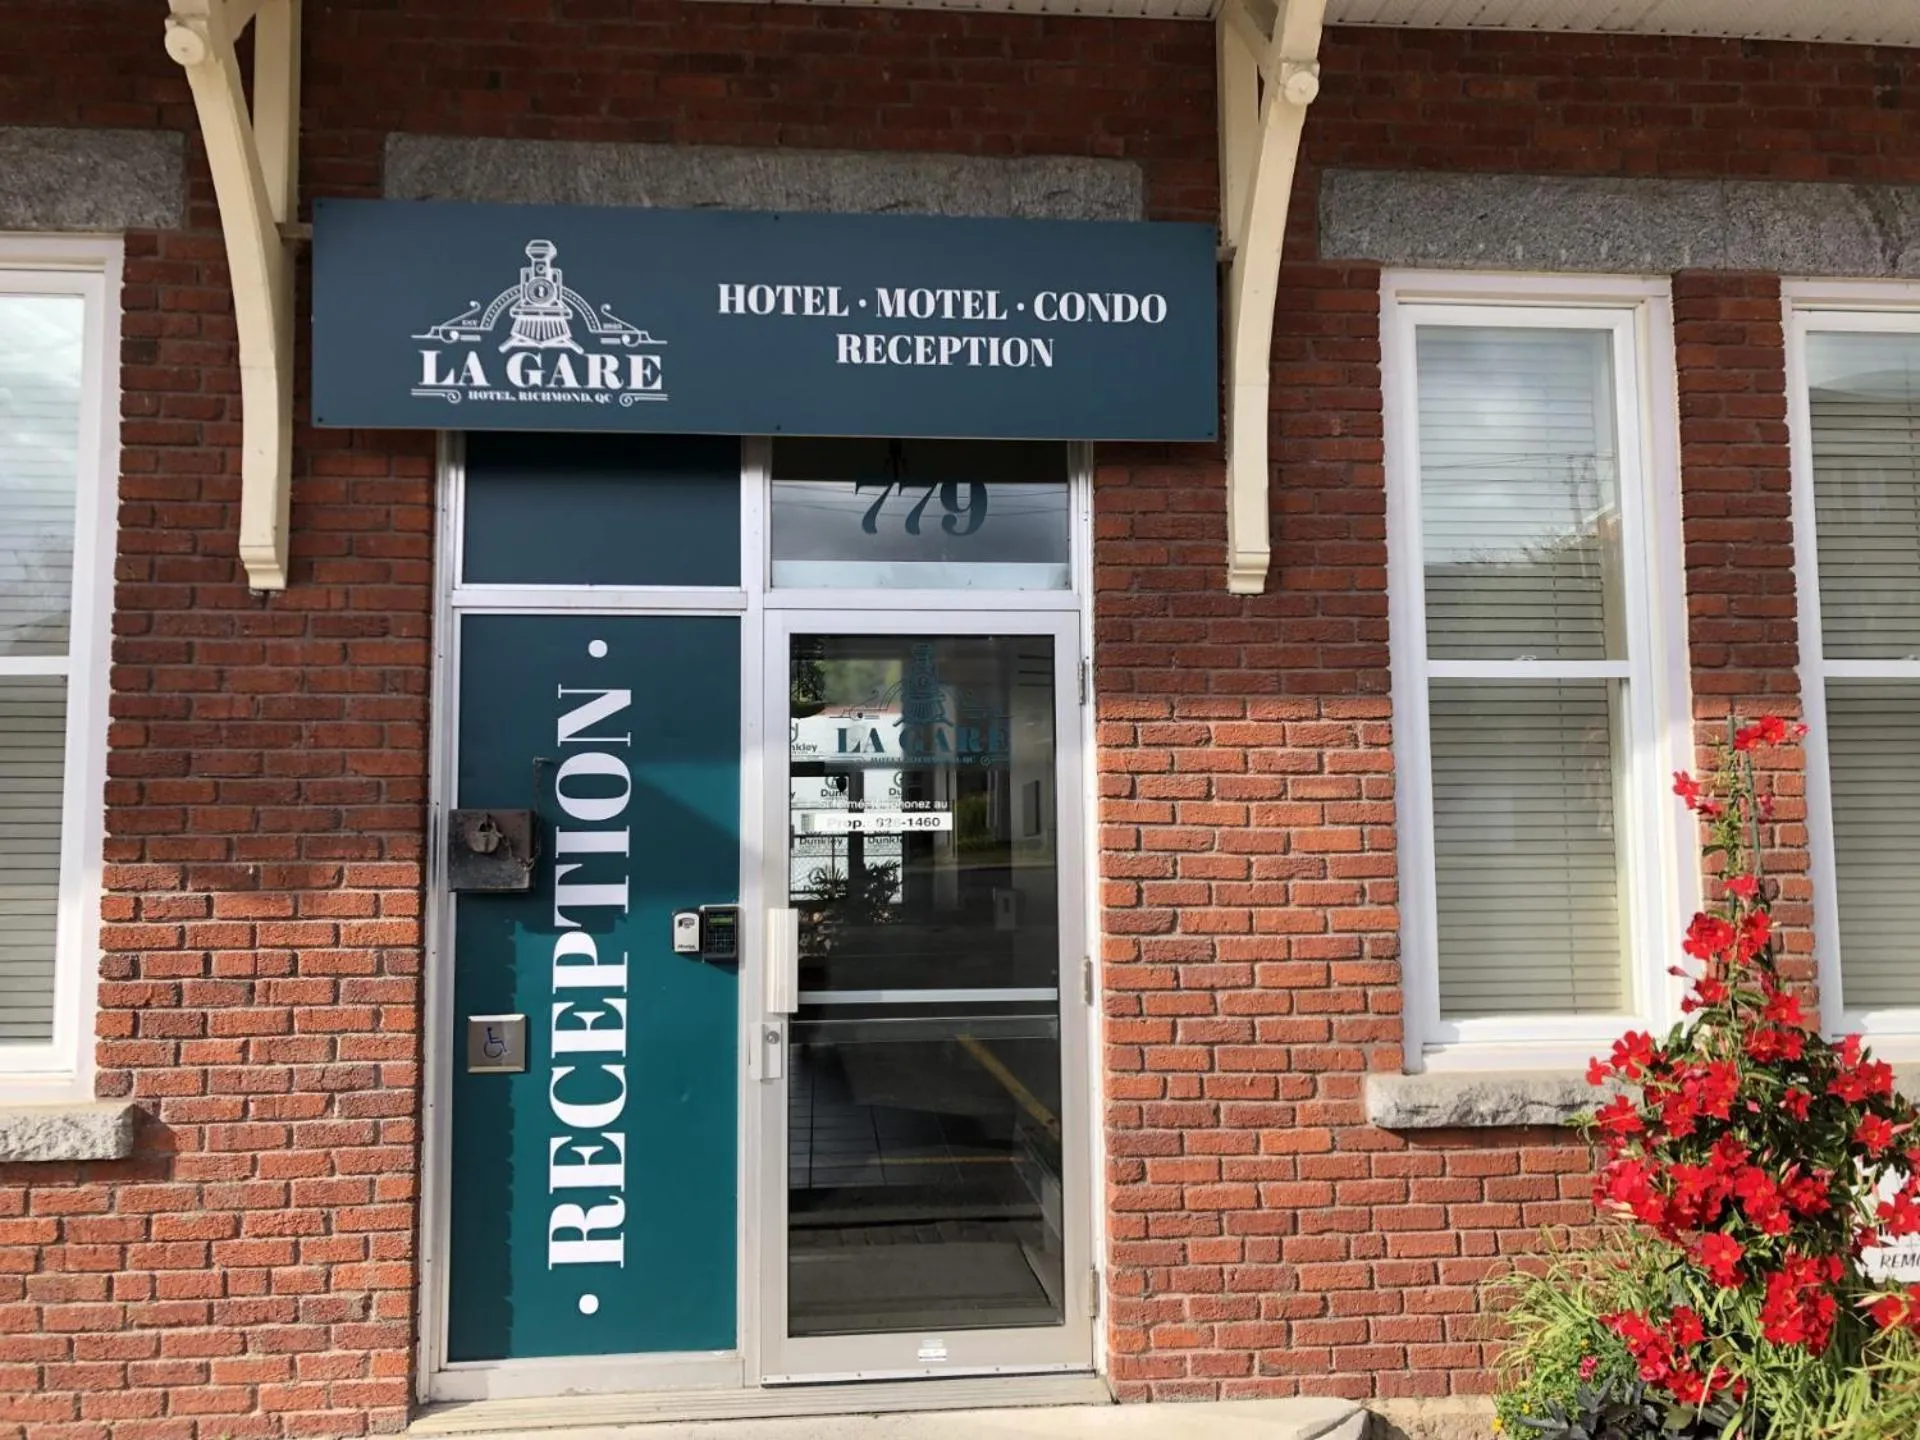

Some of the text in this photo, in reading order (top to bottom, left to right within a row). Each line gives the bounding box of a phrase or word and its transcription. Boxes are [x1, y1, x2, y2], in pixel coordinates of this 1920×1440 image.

[718, 283, 1168, 324] HOTEL MOTEL CONDO
[418, 350, 663, 391] LA GARE
[836, 332, 1054, 368] RECEPTION
[855, 474, 988, 536] 779
[836, 727, 886, 753] LA
[548, 684, 632, 1271] RECEPTION
